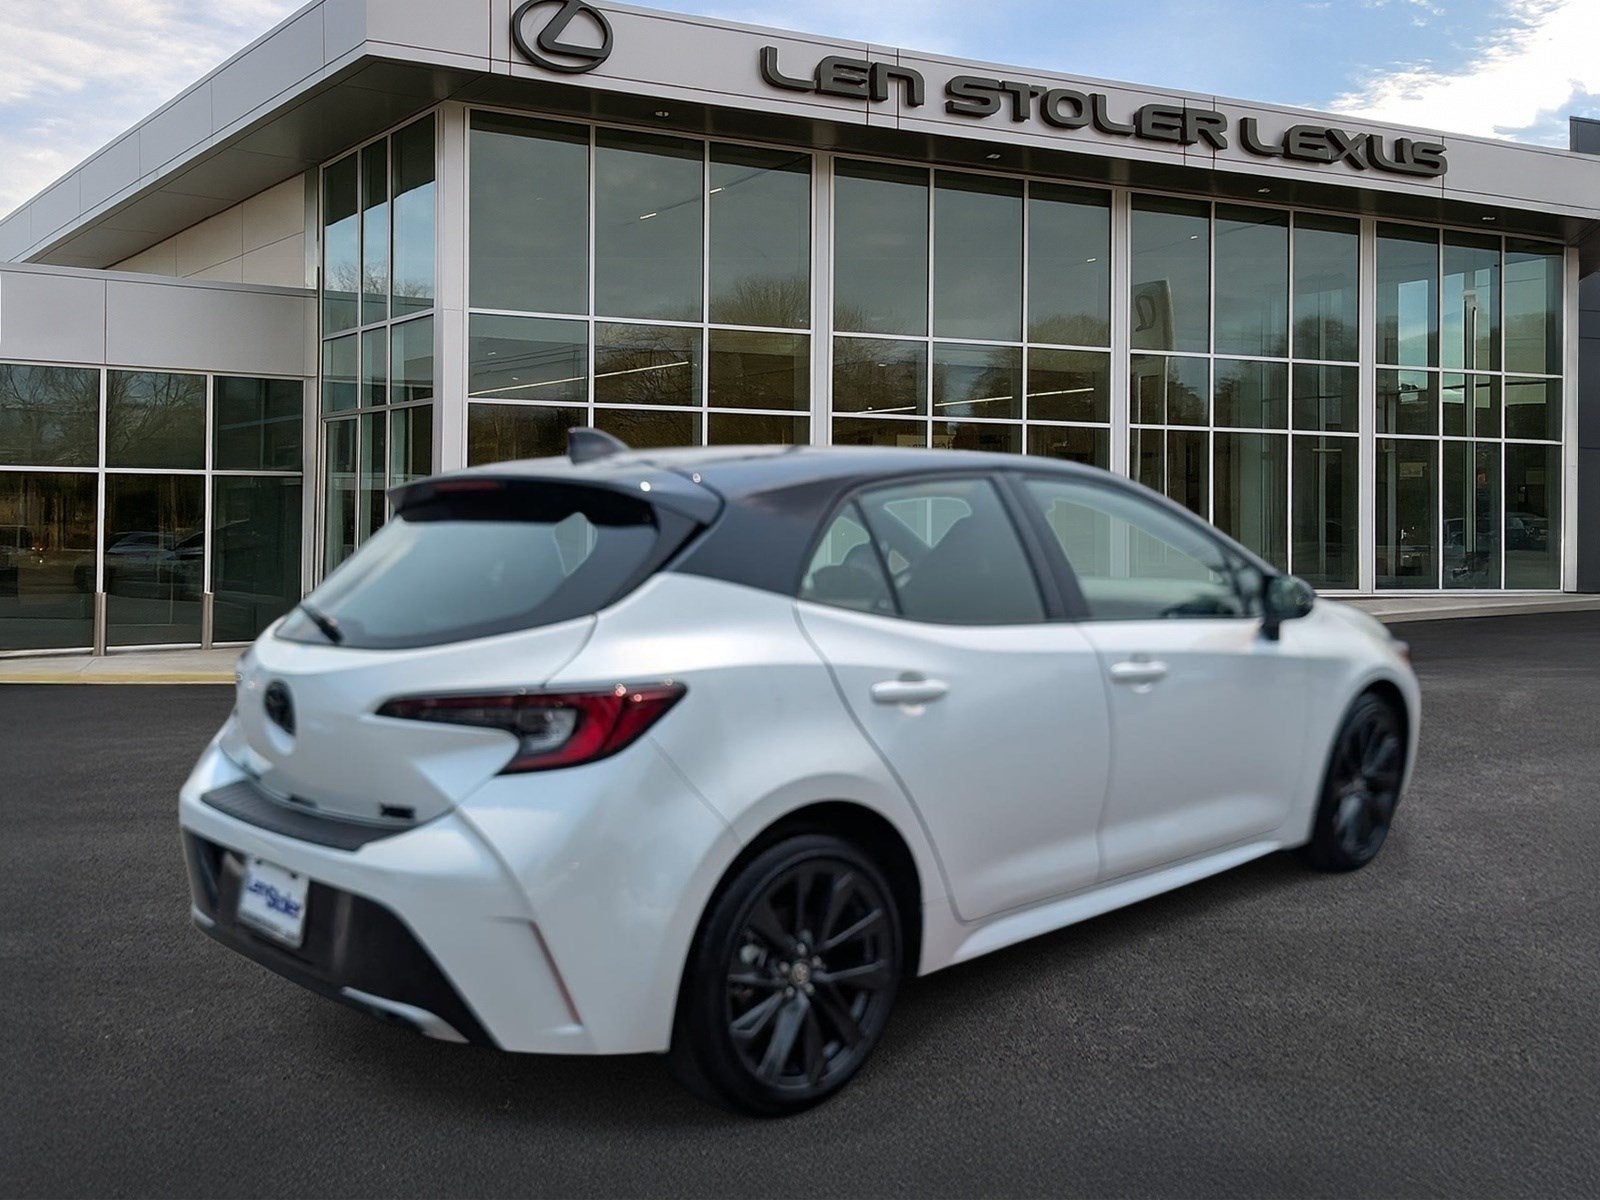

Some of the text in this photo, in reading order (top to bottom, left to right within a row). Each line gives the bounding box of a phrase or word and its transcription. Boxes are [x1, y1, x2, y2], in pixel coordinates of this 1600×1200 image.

[760, 46, 1448, 178] LEN STOLER LEXUS
